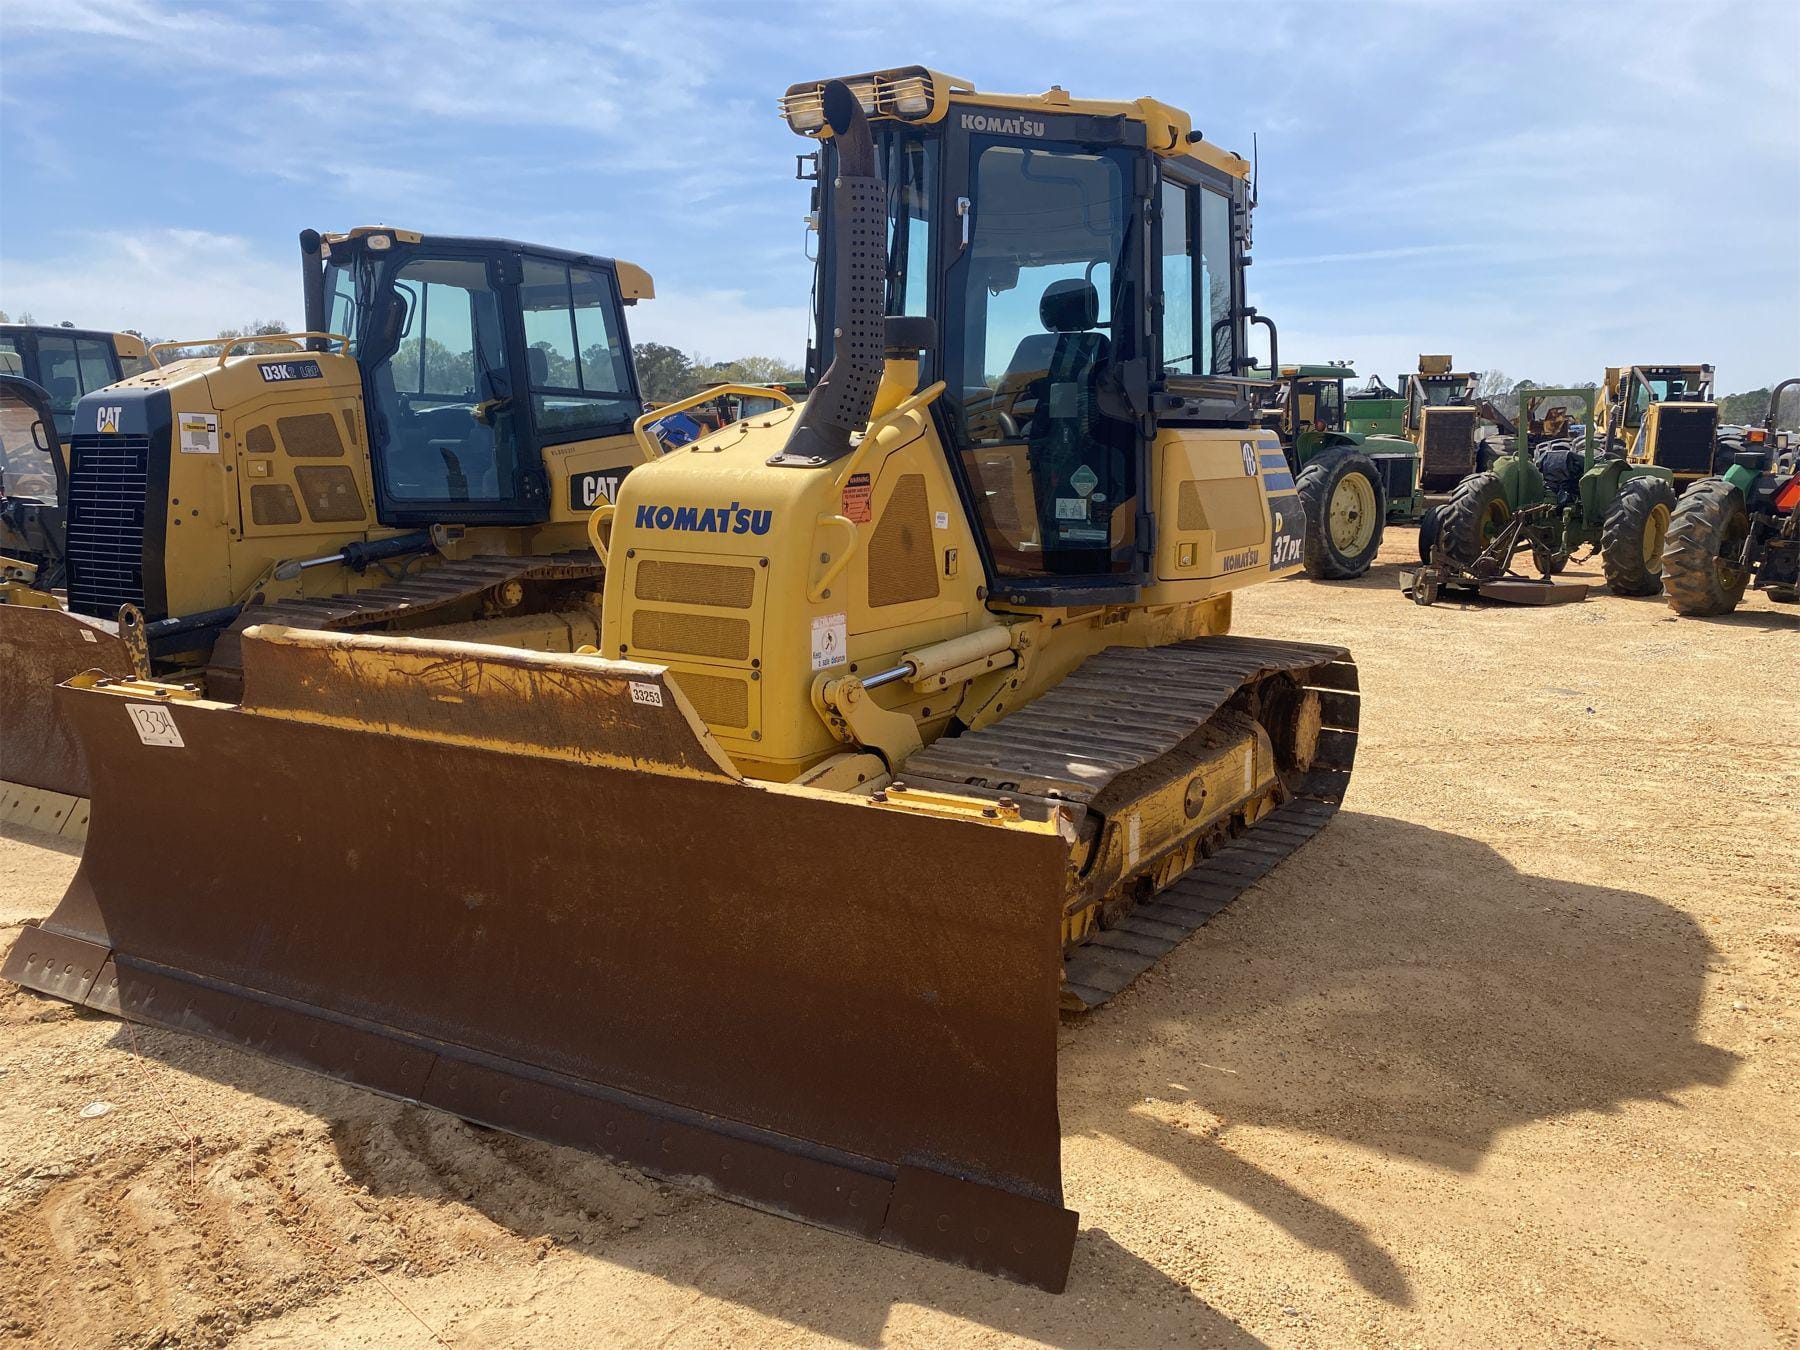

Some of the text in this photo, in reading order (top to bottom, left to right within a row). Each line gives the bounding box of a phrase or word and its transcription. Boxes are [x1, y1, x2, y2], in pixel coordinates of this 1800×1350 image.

[961, 114, 1045, 137] KOMATSU
[97, 406, 122, 433] CAT
[583, 476, 618, 506] CAT
[635, 501, 773, 536] KOMATSU
[1275, 512, 1283, 533] D
[1223, 547, 1259, 572] KOMATSU
[1273, 535, 1302, 565] 37PX
[633, 689, 661, 704] 33253
[133, 708, 177, 738] 1334
